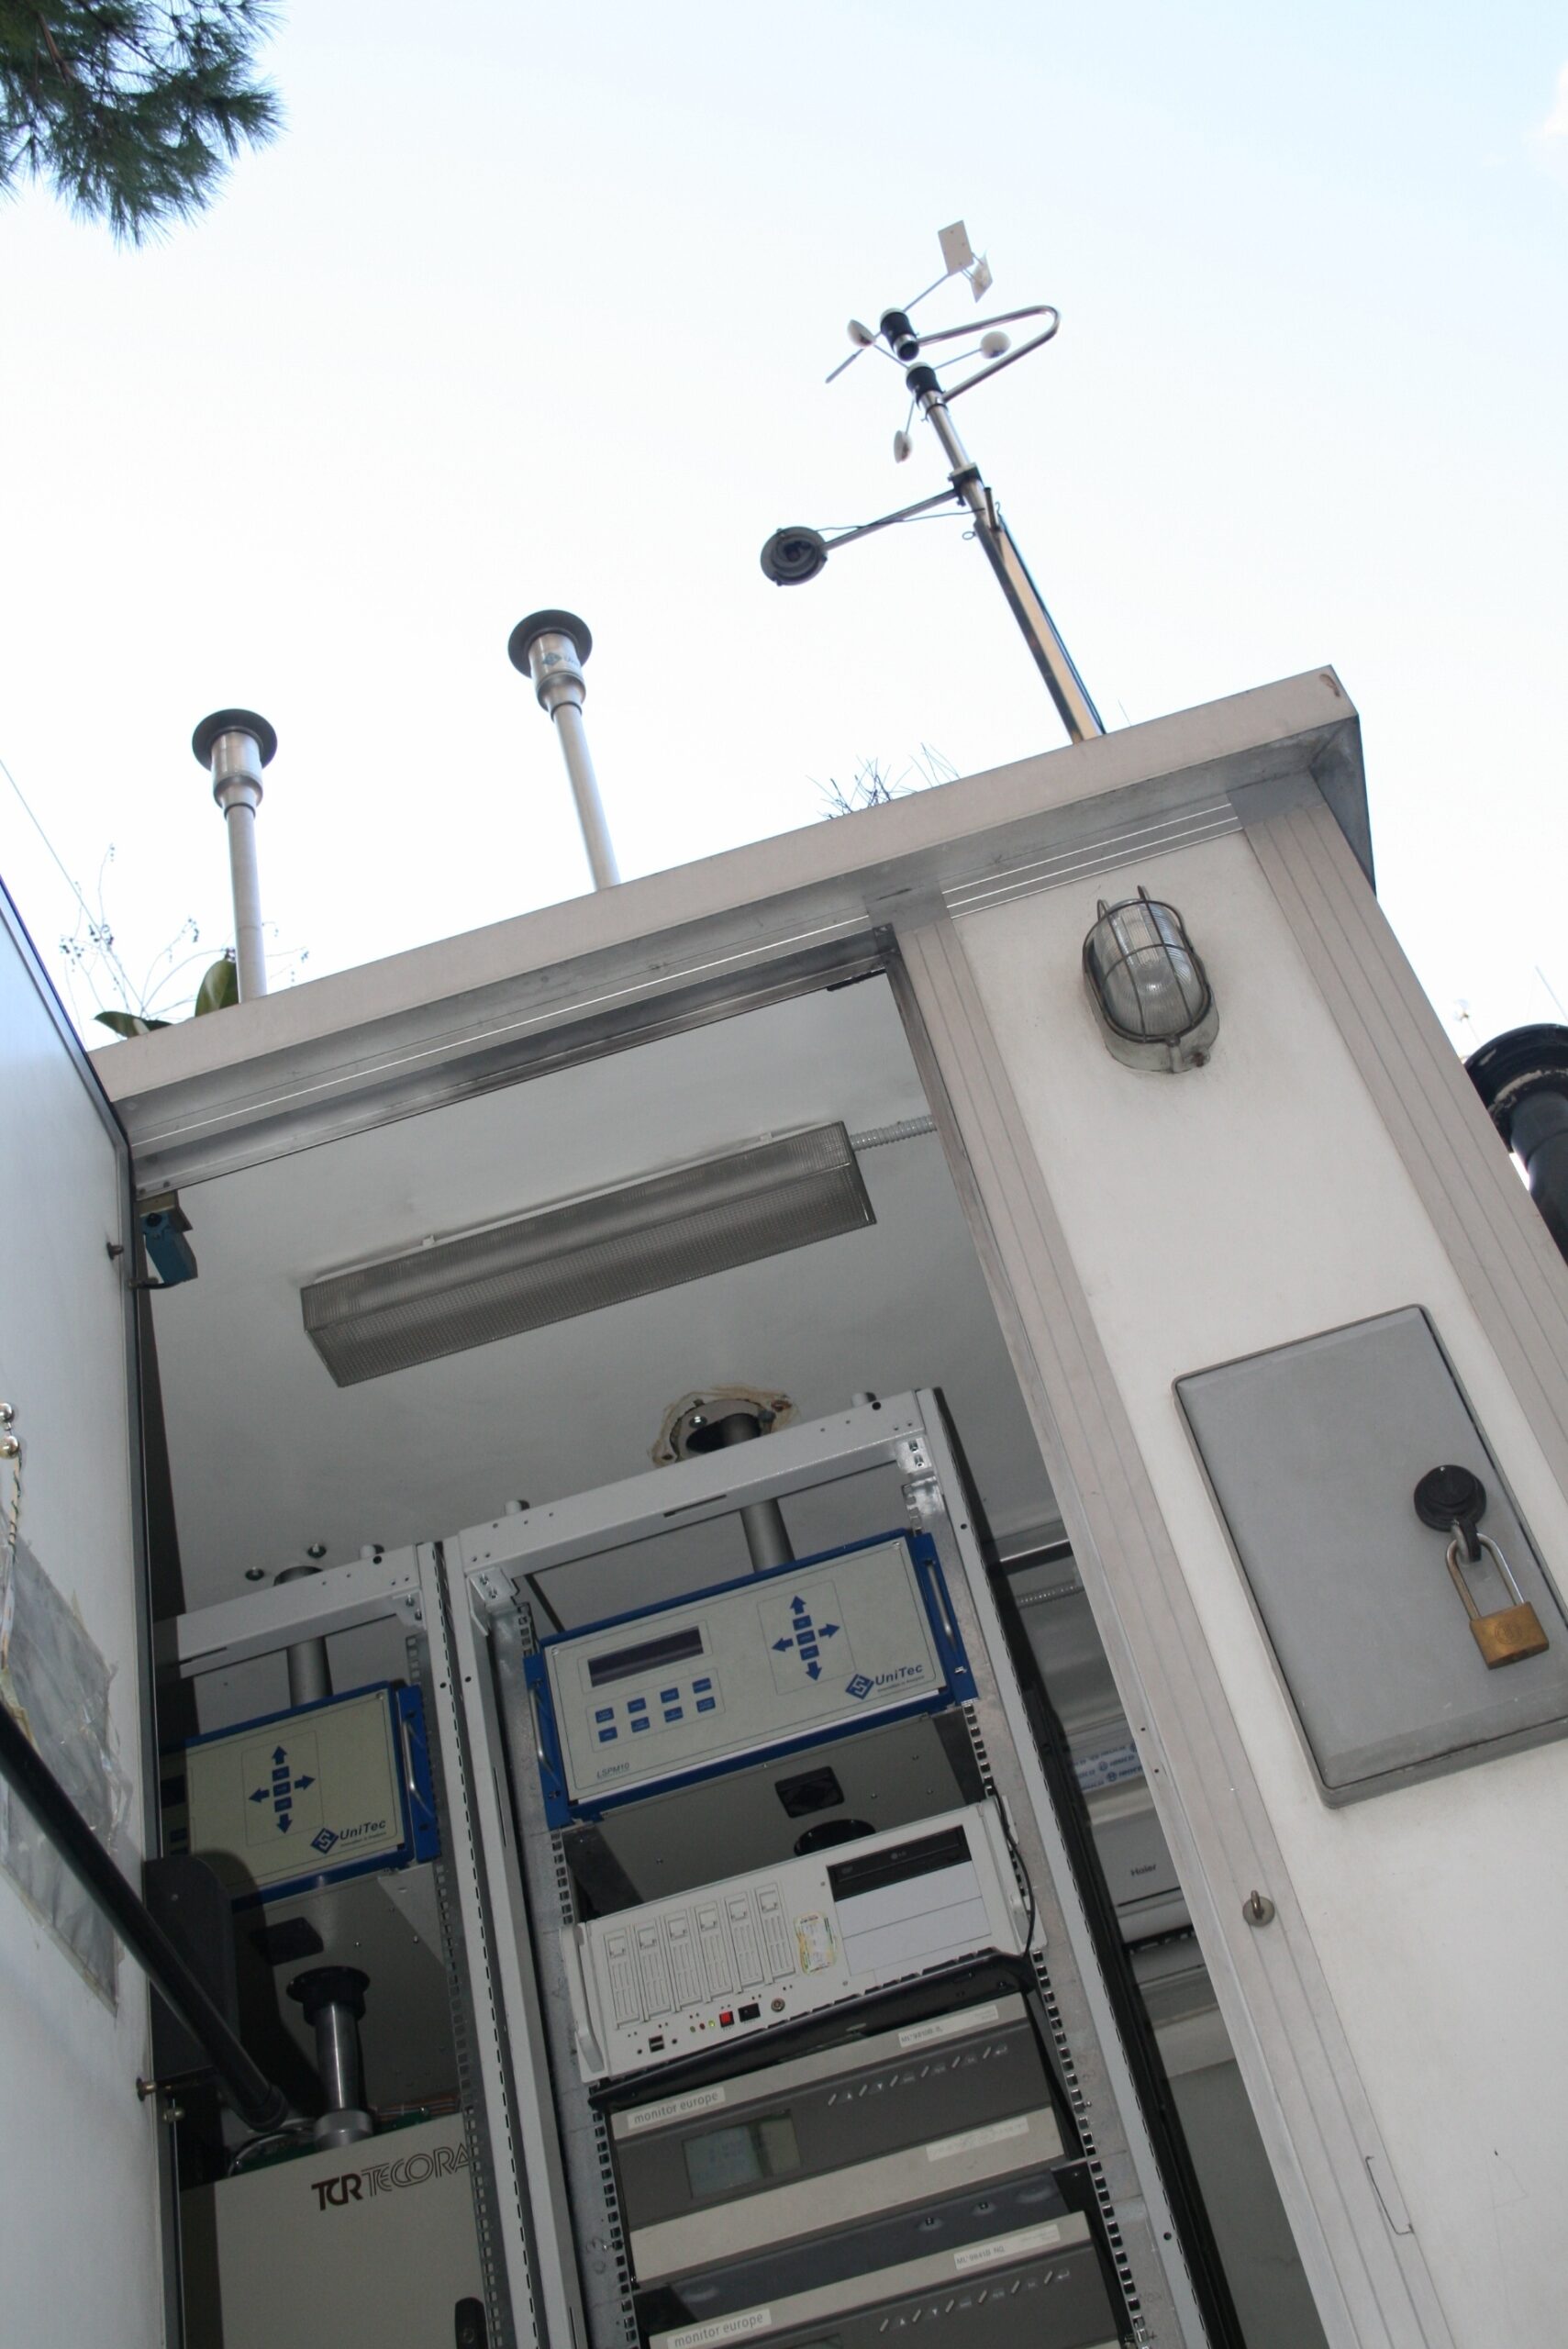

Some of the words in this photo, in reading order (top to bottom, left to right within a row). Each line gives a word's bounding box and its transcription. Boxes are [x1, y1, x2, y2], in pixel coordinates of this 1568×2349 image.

[875, 1664, 923, 1686] UniTec
[596, 1763, 630, 1778] LSPM10
[339, 1820, 386, 1840] UniTec
[1130, 1864, 1157, 1876] Haier
[634, 2105, 677, 2124] monitor
[680, 2091, 718, 2111] europe
[311, 2173, 363, 2211] TCR
[674, 2325, 720, 2347] monitor
[723, 2312, 763, 2334] europe
